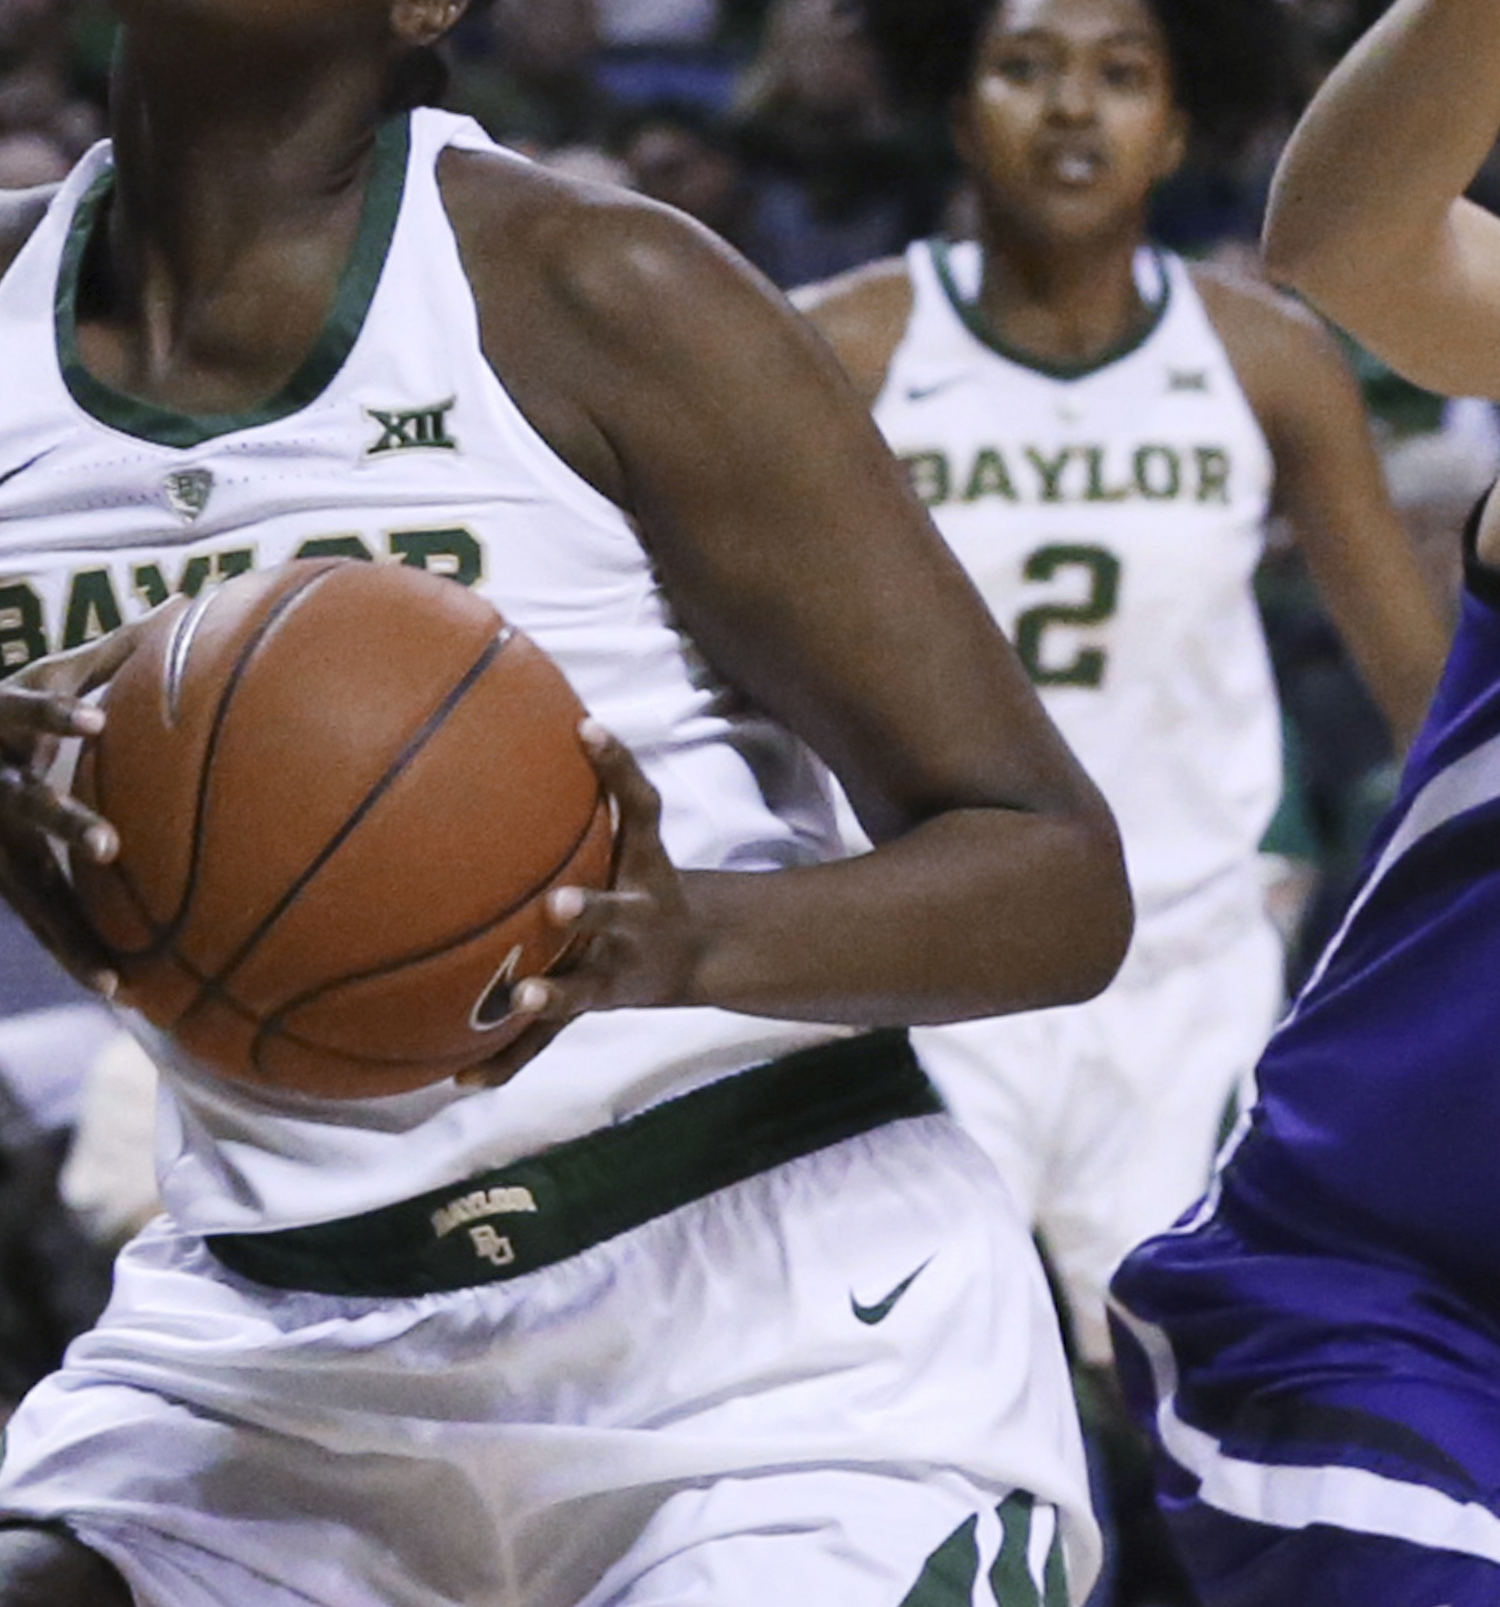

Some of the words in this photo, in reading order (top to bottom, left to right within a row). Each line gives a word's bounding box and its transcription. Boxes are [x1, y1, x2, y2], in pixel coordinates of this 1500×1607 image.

[363, 394, 457, 456] XII
[902, 444, 1231, 507] BAYLOR
[1014, 544, 1121, 688] 2
